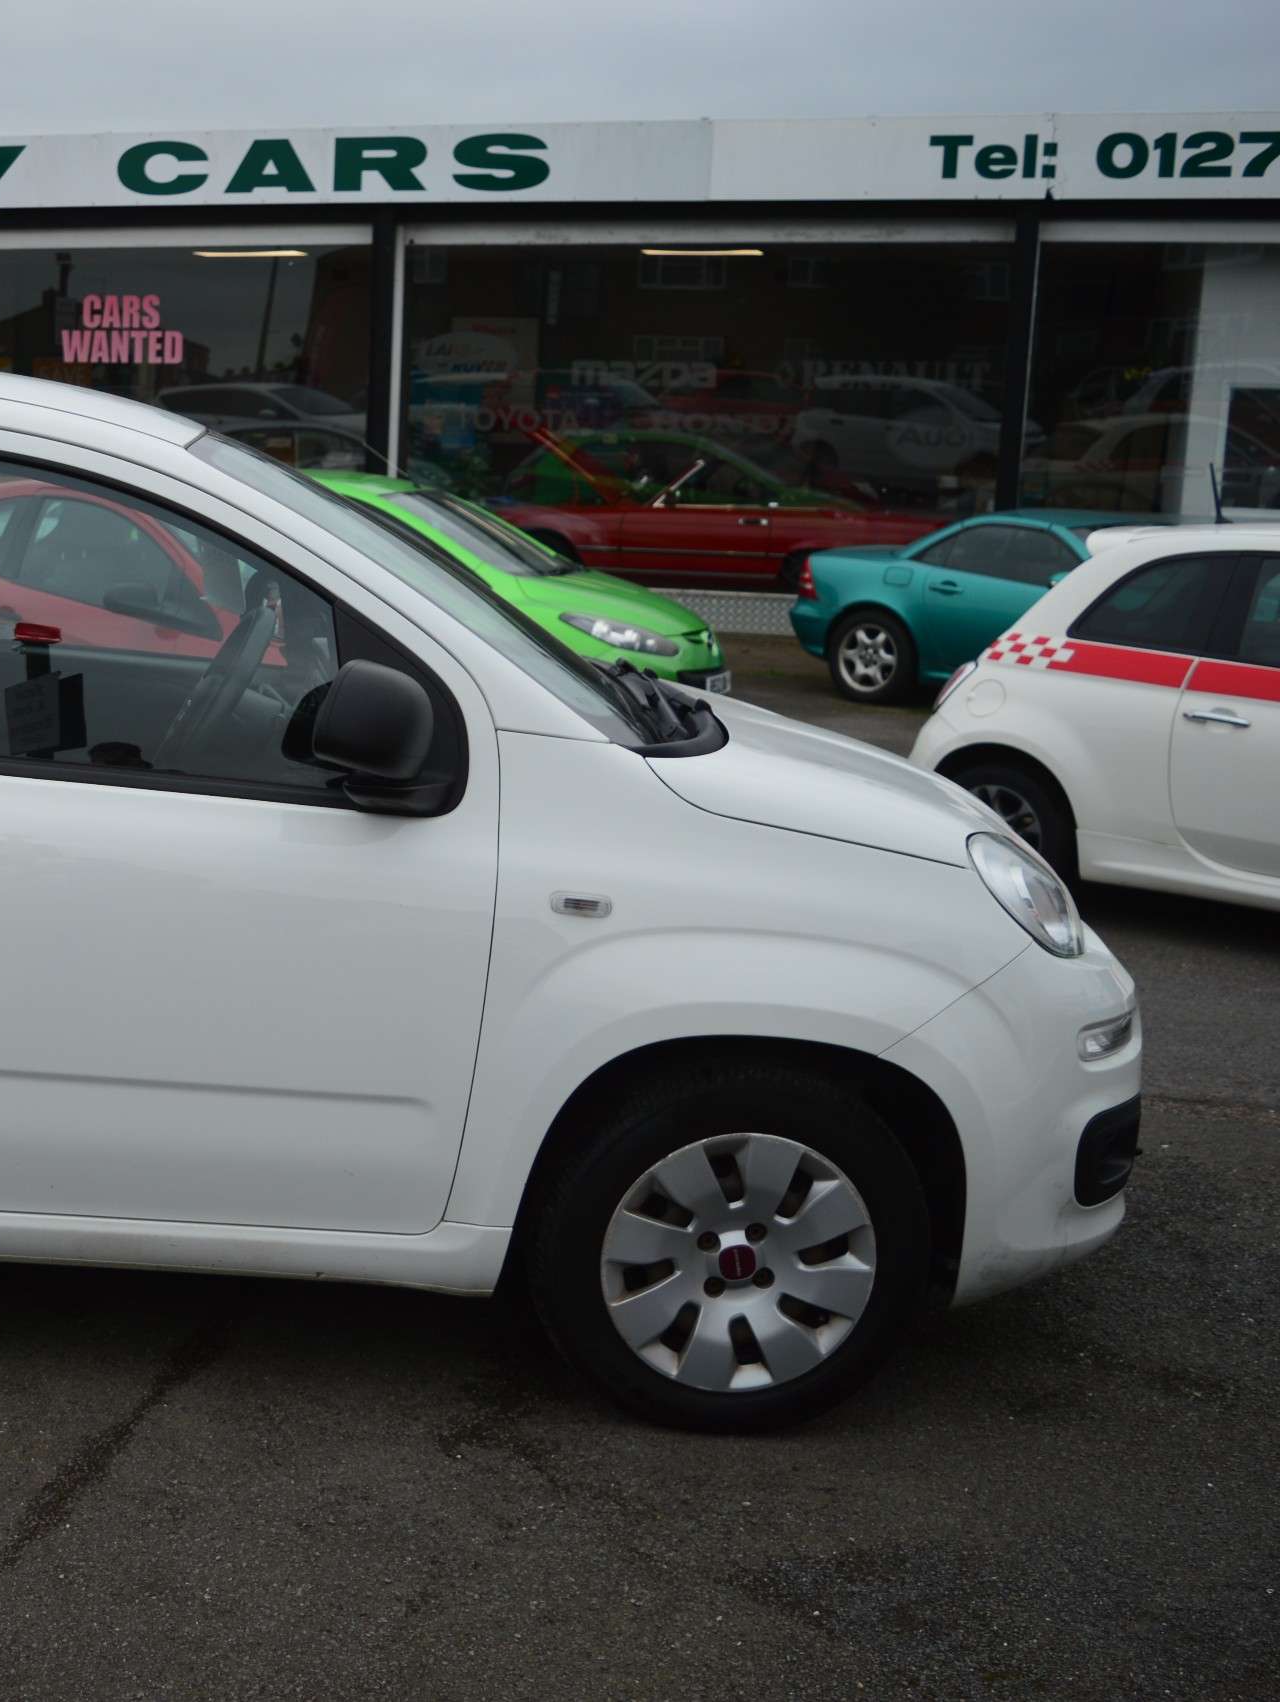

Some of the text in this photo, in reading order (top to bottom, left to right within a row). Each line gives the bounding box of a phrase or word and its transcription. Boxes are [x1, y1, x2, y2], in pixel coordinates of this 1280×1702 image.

[116, 133, 550, 195] CARS
[929, 131, 1280, 180] Tel: 0127
[82, 294, 160, 329] CARS
[61, 330, 183, 365] WANTED
[457, 405, 579, 435] TOYOTA
